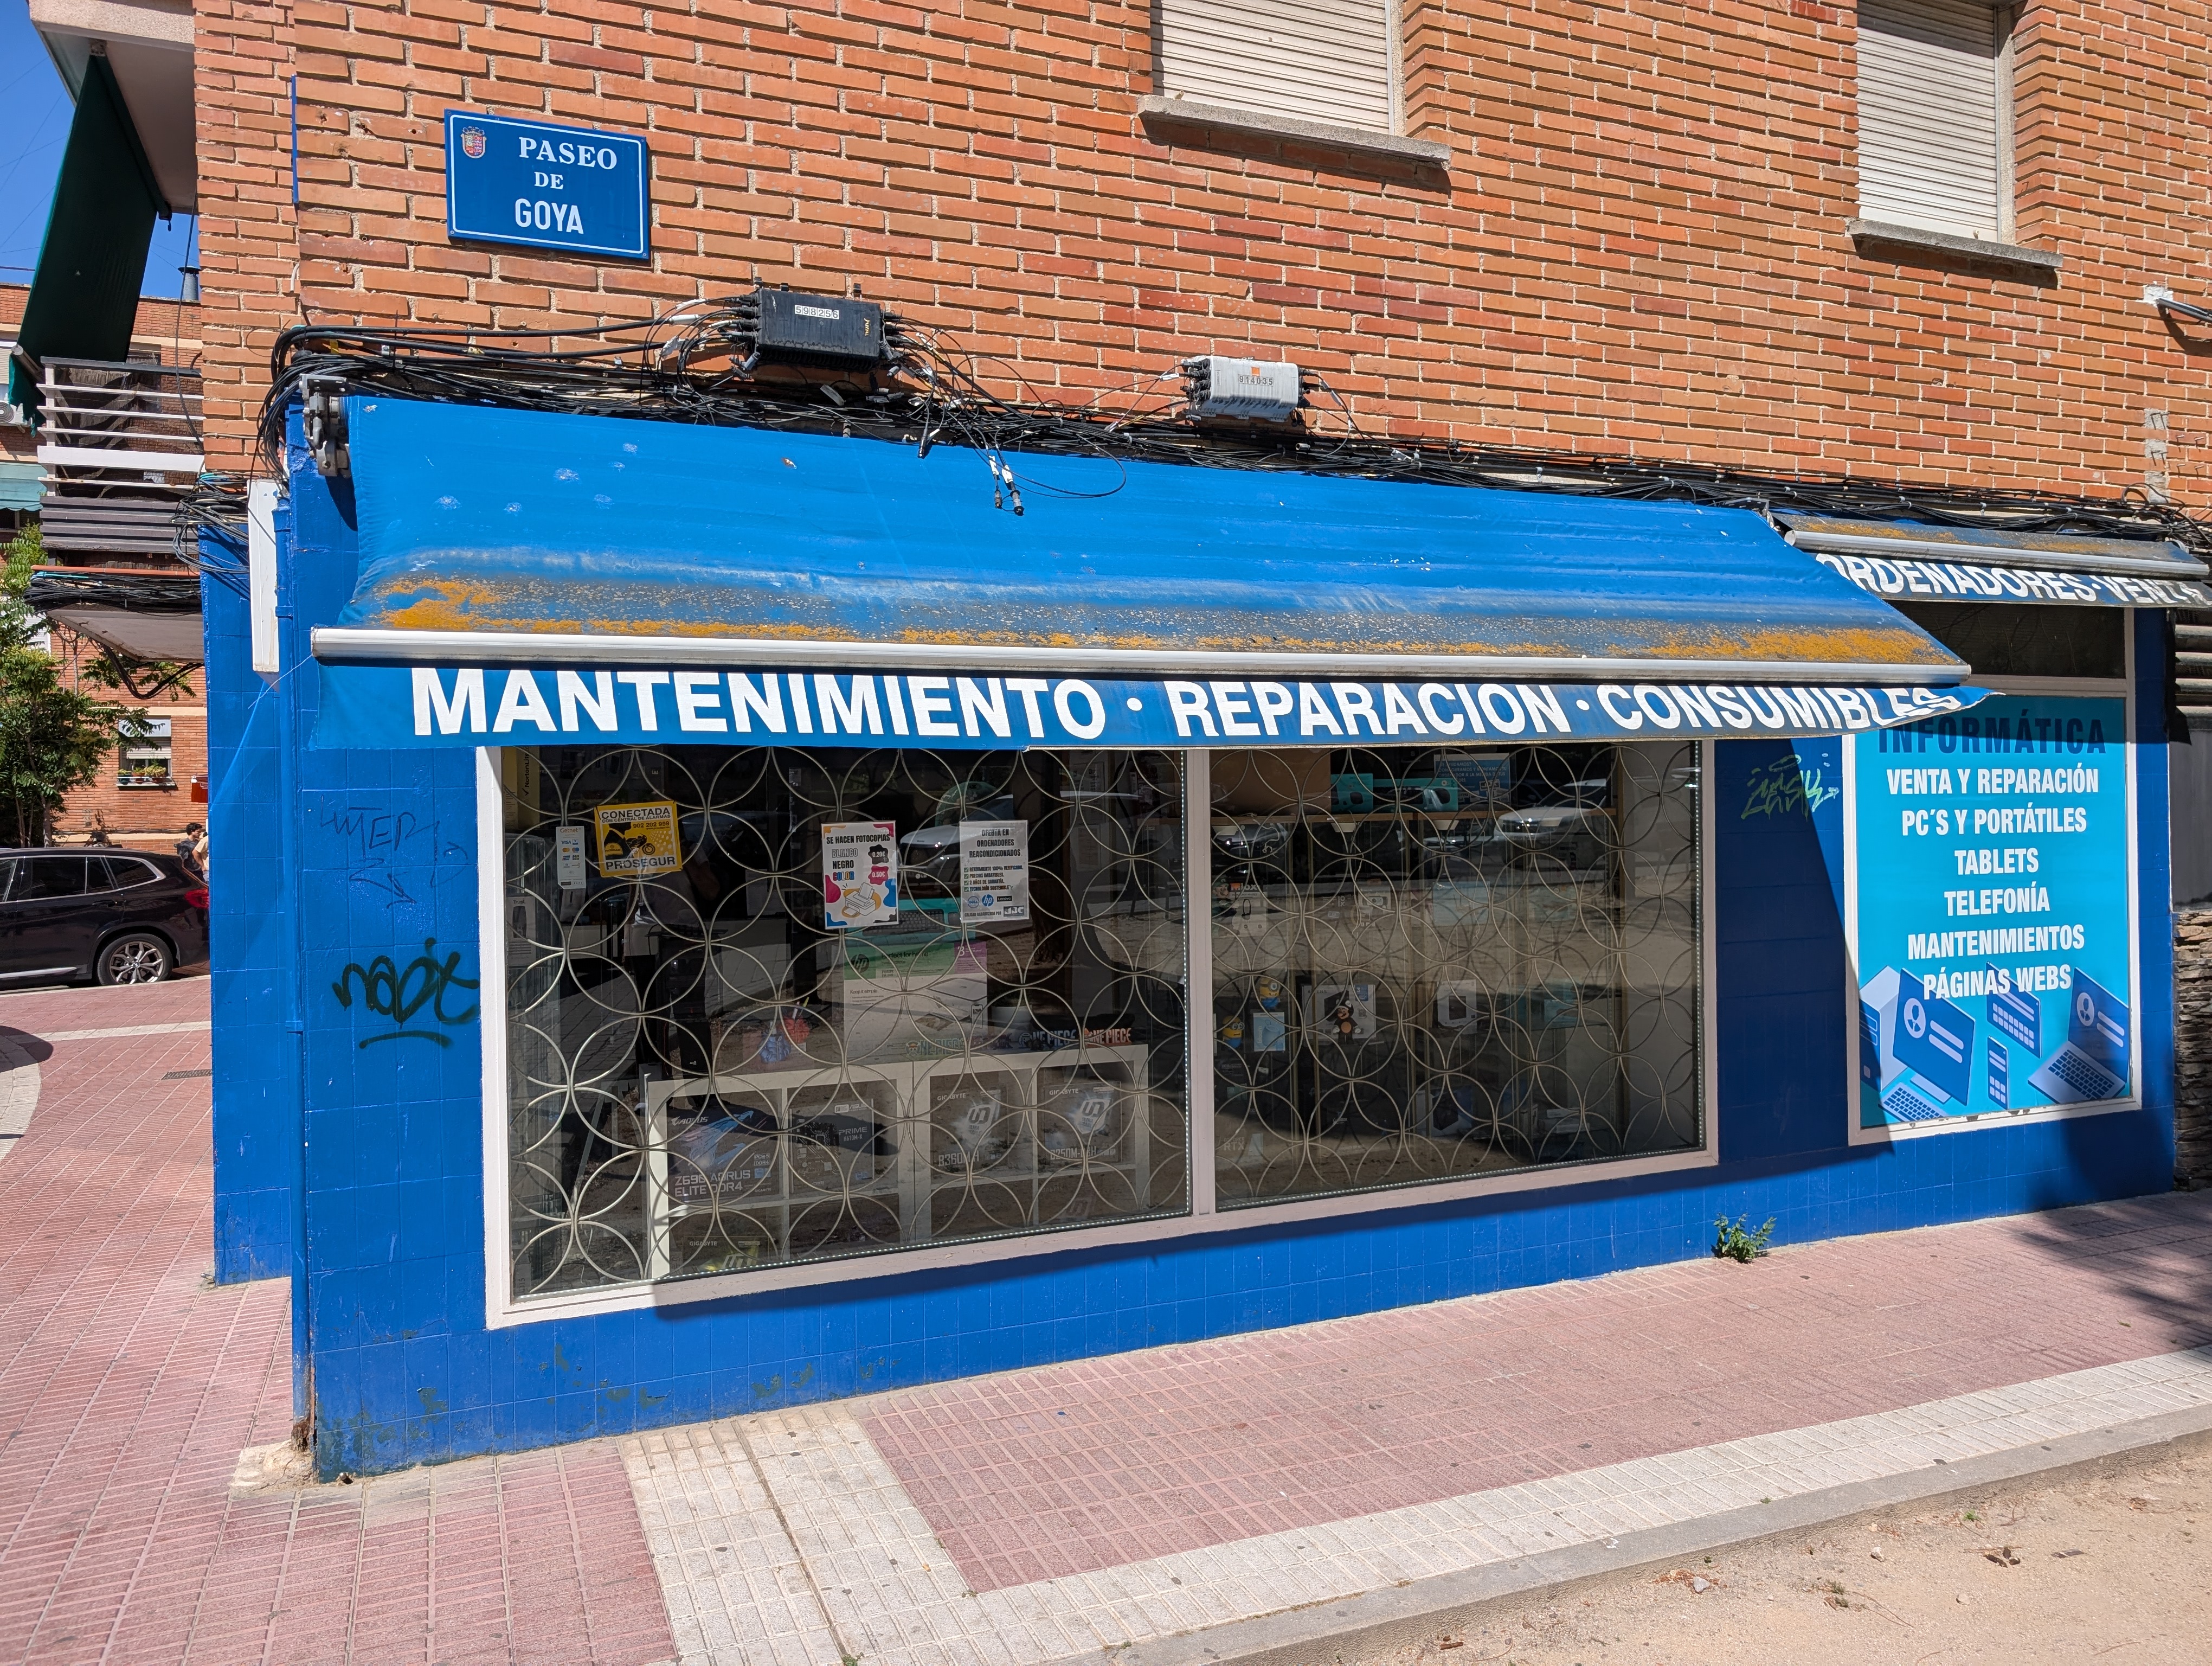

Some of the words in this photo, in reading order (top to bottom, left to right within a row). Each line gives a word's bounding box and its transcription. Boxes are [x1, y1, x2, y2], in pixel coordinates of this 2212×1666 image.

[519, 137, 617, 170] PASEO
[534, 171, 564, 190] DE
[515, 198, 584, 234] GOYA
[795, 305, 839, 319] 598256
[1239, 375, 1274, 386] 914035
[1816, 553, 2097, 601] ORDENADORES
[411, 668, 1105, 739] MANTENIMIENTO
[1164, 680, 1572, 737] REPARACION
[1597, 683, 1962, 730] CONSUMIBLES
[1879, 709, 2106, 754] INFORMÁTICA
[1887, 768, 1952, 794] VENTA
[1957, 768, 1970, 794] Y
[1978, 762, 2099, 794] REPARACIÓN
[601, 807, 670, 819] CONECTADA
[1954, 809, 1967, 835] Y
[1975, 802, 2087, 834] PORTÁTILES
[835, 835, 854, 844] HACEN
[856, 834, 890, 843] FOTOCOPIAS
[976, 839, 1014, 847] ORDENADORES
[832, 848, 858, 858] BLANCO
[969, 849, 1021, 858] REACONDICIONADOS
[606, 856, 676, 870] PROSEGUR
[832, 860, 854, 869] NEGRO
[1954, 848, 2039, 875] TABLETS
[833, 871, 855, 881] COLOR
[983, 894, 993, 907] hp
[1944, 881, 2050, 917] TELEFONÍA
[1908, 924, 2085, 960] MANTENIMIENTOS
[1924, 966, 2010, 1000] PÁGINAS
[2016, 964, 2072, 992] WEBS
[839, 1126, 867, 1136] PRIME
[1224, 1141, 1244, 1151] RTX
[674, 1185, 707, 1197] ELITE
